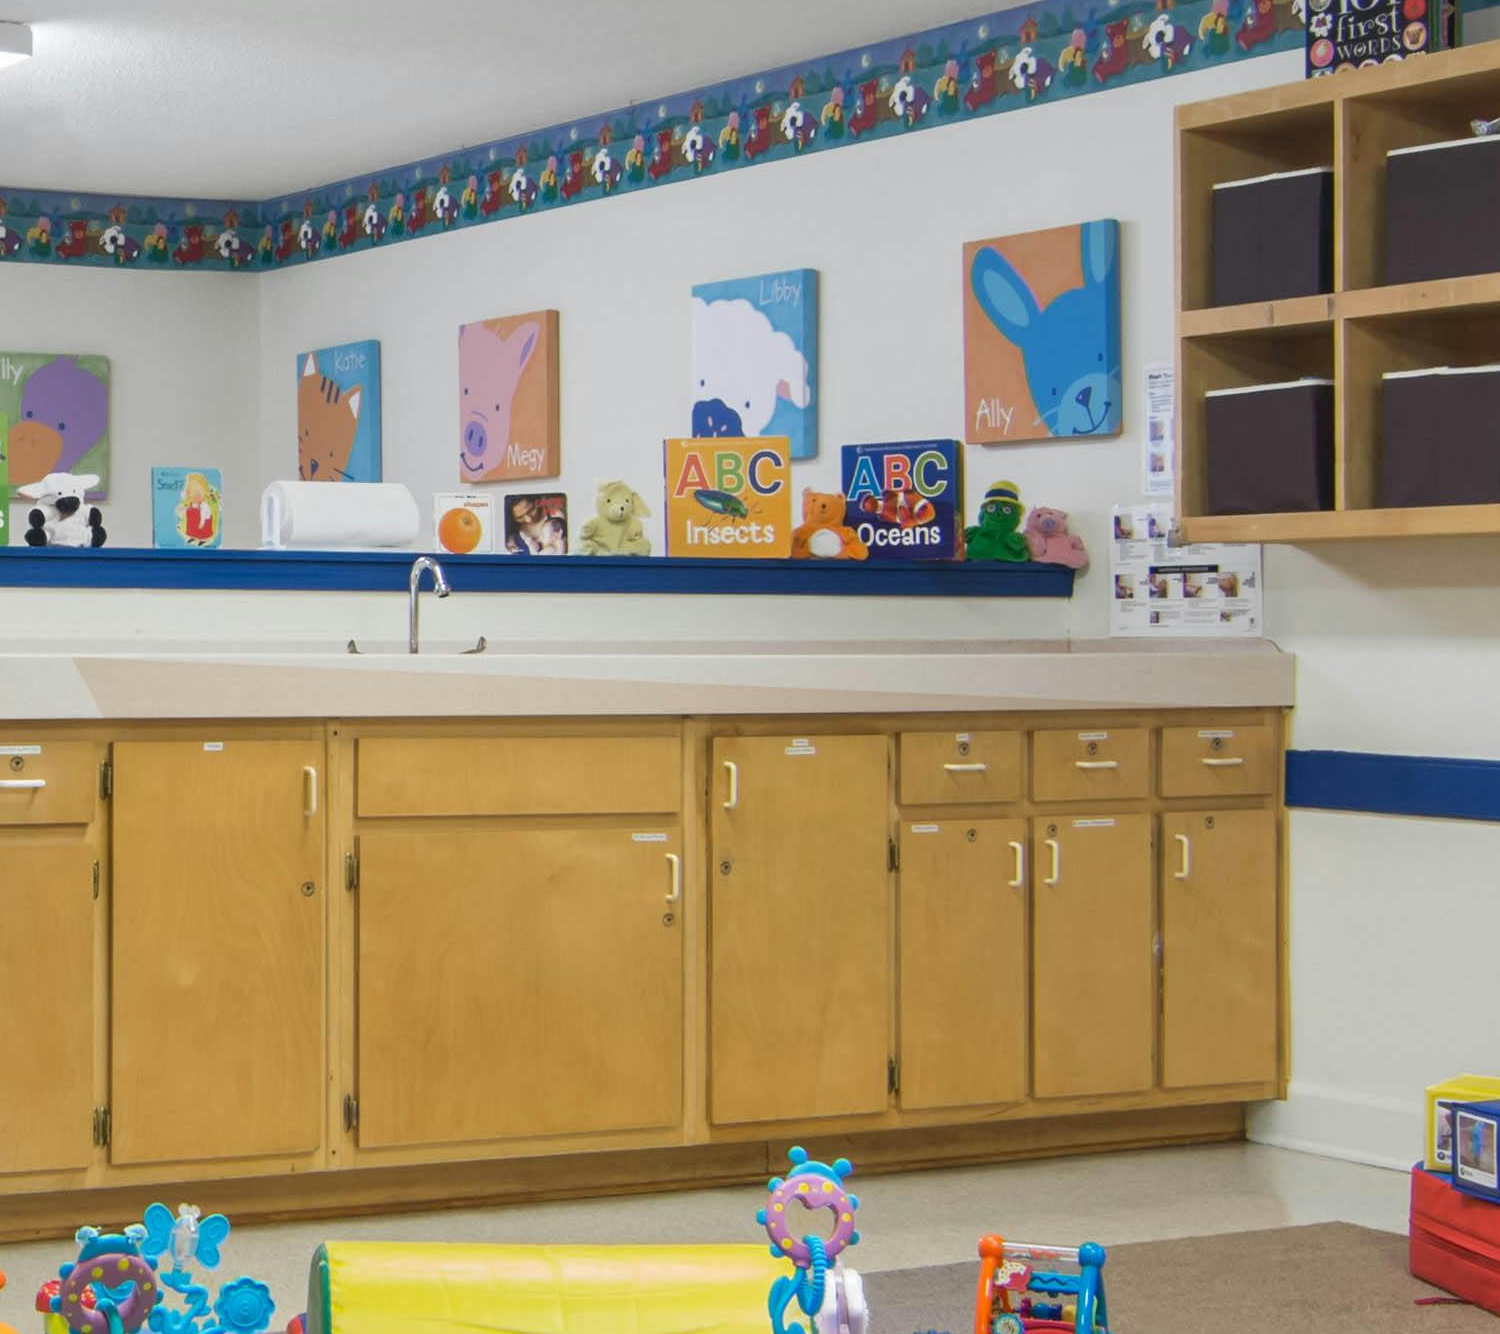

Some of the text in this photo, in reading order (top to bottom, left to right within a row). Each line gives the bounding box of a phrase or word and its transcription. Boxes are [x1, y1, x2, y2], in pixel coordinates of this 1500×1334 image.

[1337, 6, 1401, 43] first
[1336, 35, 1402, 60] WORDS
[760, 278, 802, 307] Libby
[976, 398, 1015, 436] Ally
[507, 443, 545, 472] Megy
[673, 450, 785, 499] ABC
[847, 451, 948, 501] ABC
[686, 519, 775, 547] Insects
[858, 523, 941, 547] Oceans
